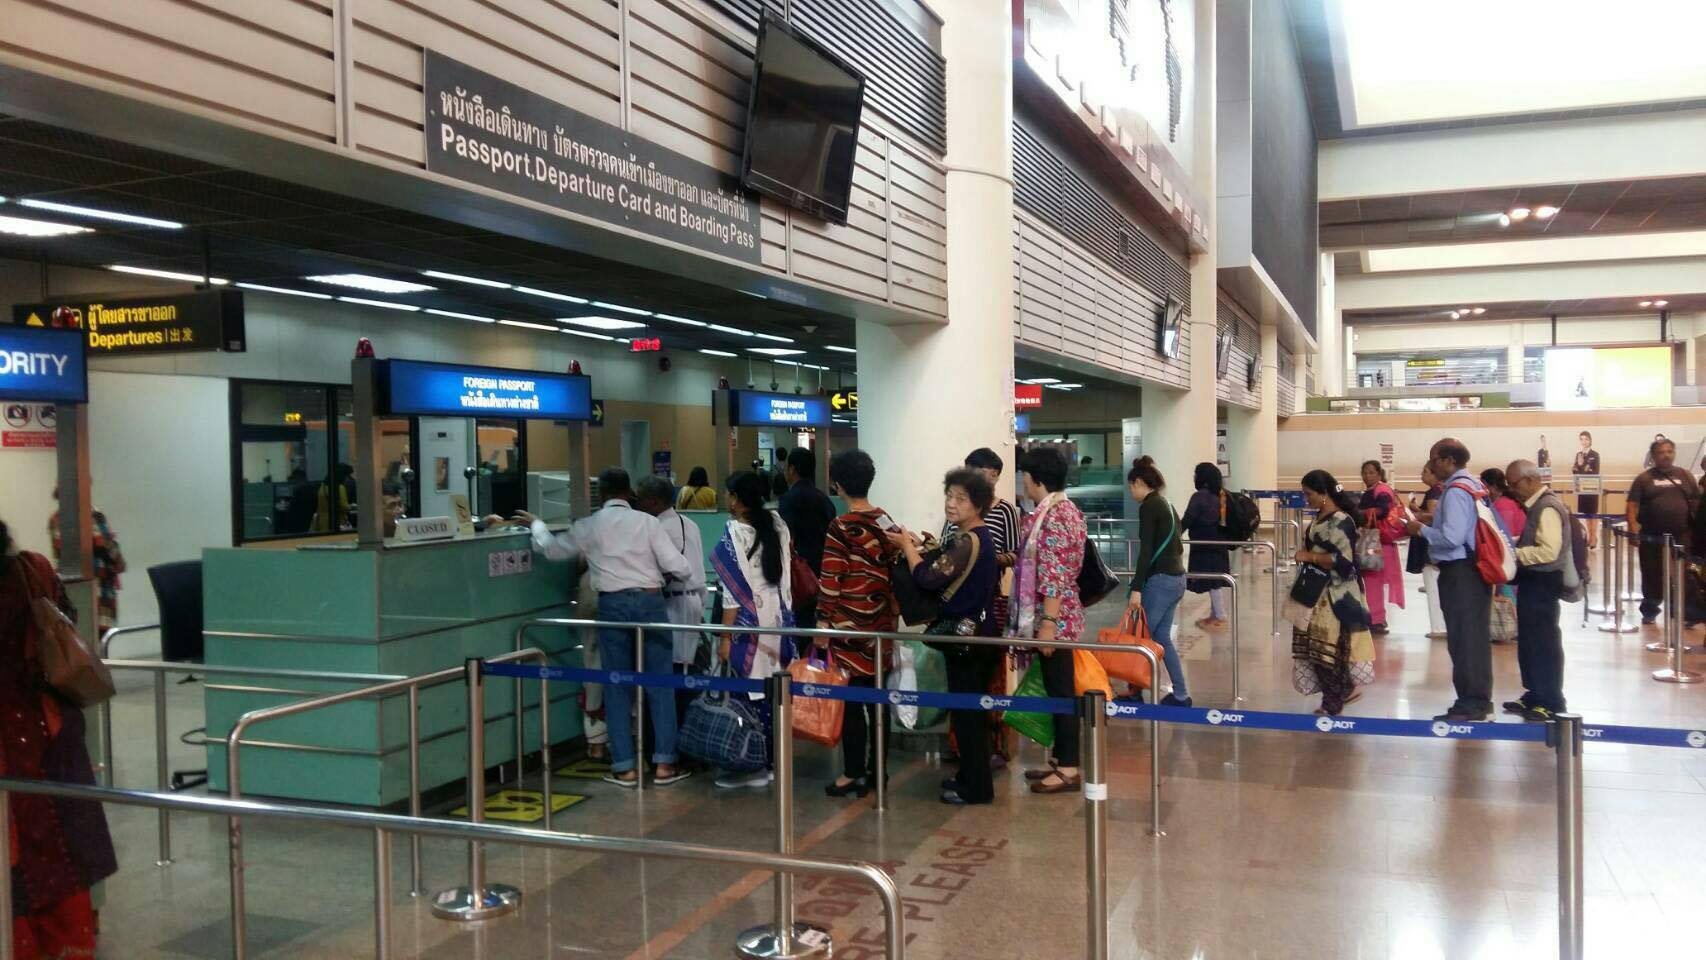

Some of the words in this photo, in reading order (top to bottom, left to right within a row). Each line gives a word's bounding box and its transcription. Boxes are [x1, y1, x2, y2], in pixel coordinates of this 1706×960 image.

[440, 86, 548, 150] หนังสือเดินทาง
[618, 184, 651, 216] Card
[654, 201, 677, 224] and
[680, 205, 728, 244] Boarding
[730, 223, 754, 248] Pass
[89, 330, 163, 349] Departures
[463, 377, 498, 389] FOREIGN
[498, 379, 535, 392] PASSPORT
[406, 522, 448, 534] CLOSED
[1118, 706, 1138, 714] AOT
[1223, 714, 1244, 722] AOT
[1332, 721, 1356, 729] AOT
[1450, 725, 1474, 734] AOT
[901, 836, 1009, 921] PLEASE
